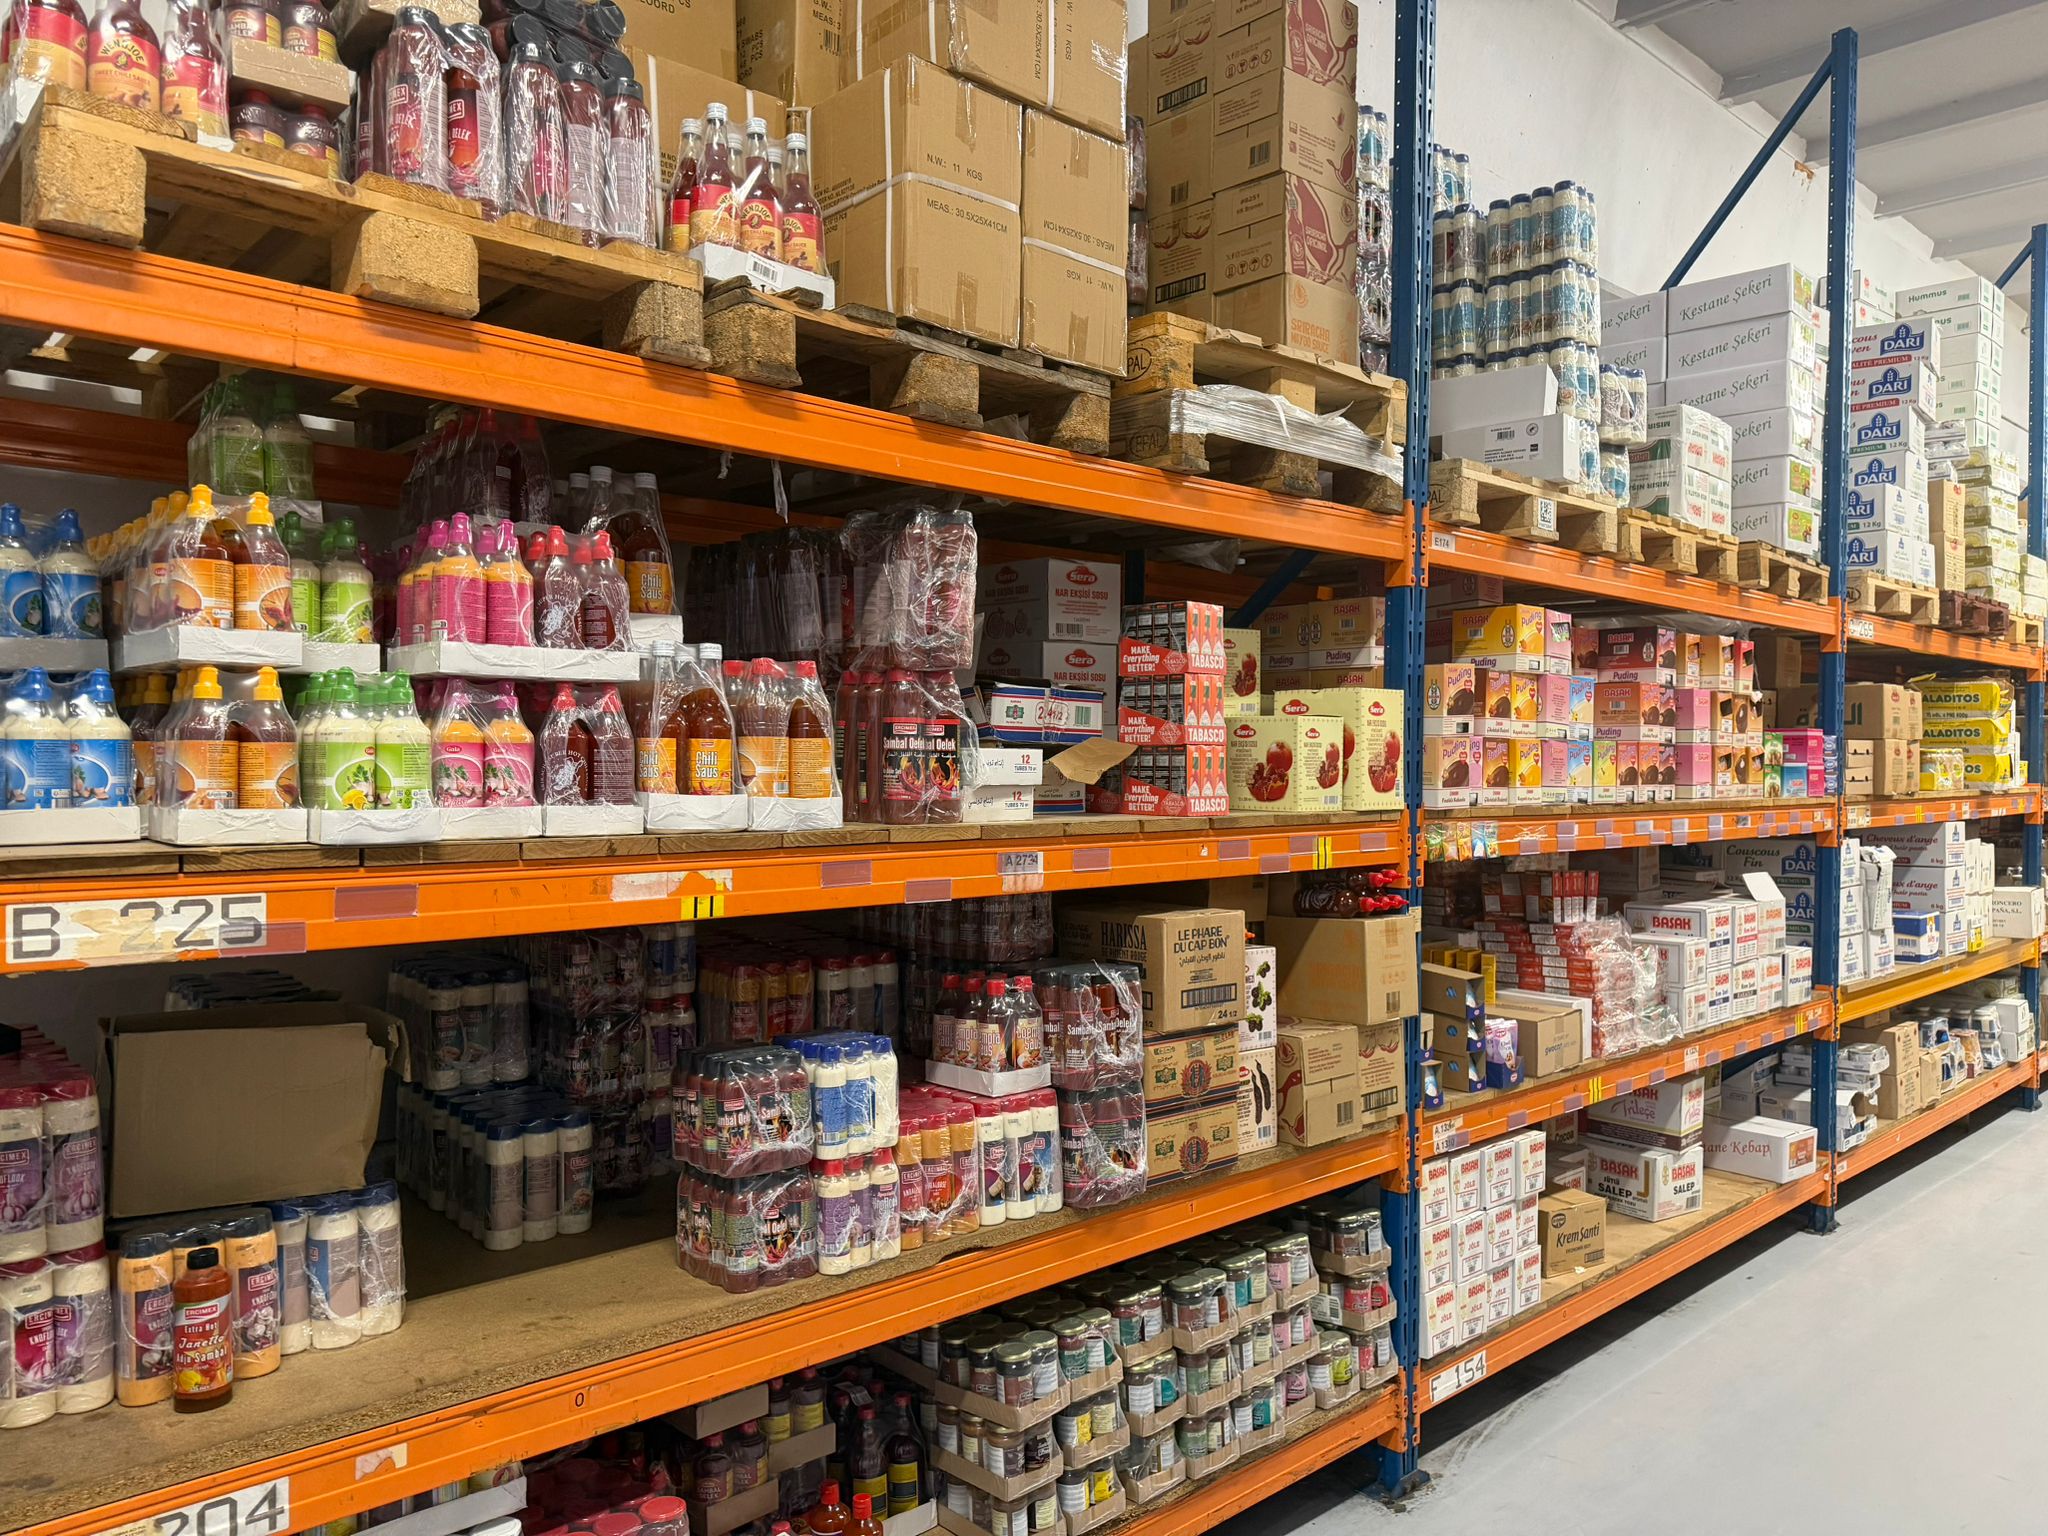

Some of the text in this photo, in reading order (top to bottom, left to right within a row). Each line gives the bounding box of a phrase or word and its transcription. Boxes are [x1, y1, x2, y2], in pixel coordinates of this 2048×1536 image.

[1064, 40, 1073, 62] KGS
[953, 163, 961, 173] 11
[966, 168, 984, 182] KGS
[1066, 269, 1082, 281] KGS
[1679, 273, 1772, 321] Kestane Şekeri
[1908, 288, 1948, 304] Hummus
[1615, 300, 1652, 328] Şekeri
[1679, 322, 1772, 368] Kestane Şekeri
[1883, 336, 1920, 351] DARI
[1730, 370, 1770, 398] Şekeri
[1871, 380, 1908, 395] DARI
[1861, 425, 1897, 440] DARI
[1857, 470, 1893, 484] DARI
[1847, 503, 1871, 516] ARI
[1434, 536, 1450, 549] E174
[1848, 549, 1875, 563] ARI
[641, 573, 662, 588] Chili
[1068, 569, 1098, 583] Sera
[640, 586, 663, 600] Saus
[1055, 587, 1069, 598] NAR
[1091, 590, 1109, 601] SOSU
[1521, 609, 1543, 626] Puding
[1130, 645, 1151, 655] MAKE
[1325, 650, 1352, 663] Puding
[1068, 653, 1094, 666] Sera
[1122, 653, 1160, 665] Everything
[1191, 653, 1225, 670] TABASCO
[1269, 654, 1294, 667] Puding
[1470, 657, 1497, 669] Puding
[1127, 662, 1156, 673] BETTER!
[1054, 671, 1068, 682] NAR
[1447, 667, 1472, 688] Puding
[1613, 671, 1639, 682] Puding
[1515, 678, 1535, 694] Puding
[1571, 682, 1592, 696] Puding
[1922, 693, 1980, 704] ALADITOS
[1284, 704, 1308, 714] Sera
[1369, 705, 1385, 715] Sera
[1127, 716, 1147, 726] MAKE
[1120, 724, 1155, 735] Everything
[1187, 727, 1225, 743] TABASCO
[1596, 727, 1622, 738] Puding
[883, 737, 908, 750] Sambal
[936, 738, 957, 750] Oelek
[1124, 732, 1152, 743] BETTER!
[1442, 740, 1467, 759] Puding
[1519, 741, 1539, 761] Puding
[1569, 744, 1590, 759] Puding
[695, 751, 718, 766] Chili
[1021, 754, 1031, 764] 12
[695, 764, 719, 779] Saus
[1012, 791, 1023, 800] 12
[1131, 785, 1150, 795] MAKE
[1123, 792, 1159, 805] Everything
[1190, 797, 1227, 813] TABASCO
[1127, 801, 1155, 812] BETTER!
[1866, 832, 1938, 845] Cheveux d'ange
[1726, 844, 1781, 857] Couscous
[1743, 855, 1763, 868] Fin
[1784, 860, 1816, 872] DAR
[1906, 879, 1938, 891] d'ange
[1785, 907, 1815, 919] DAR
[12, 905, 61, 960] B
[1101, 922, 1147, 951] HARISSA
[1177, 926, 1223, 942] LE PHARE
[1173, 939, 1208, 955] DU CAP
[1217, 1010, 1228, 1019] 24
[1611, 1099, 1656, 1120] Trileçe
[1554, 1128, 1575, 1144] Cocoa
[1730, 1139, 1771, 1157] Kebap
[1597, 1182, 1633, 1199] SALEP
[1673, 1181, 1695, 1195] SALEP
[1556, 1231, 1580, 1248] Krem
[185, 1305, 218, 1317] ERCIMEX
[184, 1323, 203, 1333] Extra
[194, 1346, 227, 1363] Sambal
[1431, 1355, 1486, 1401] F 154
[153, 1482, 285, 1536] 204
